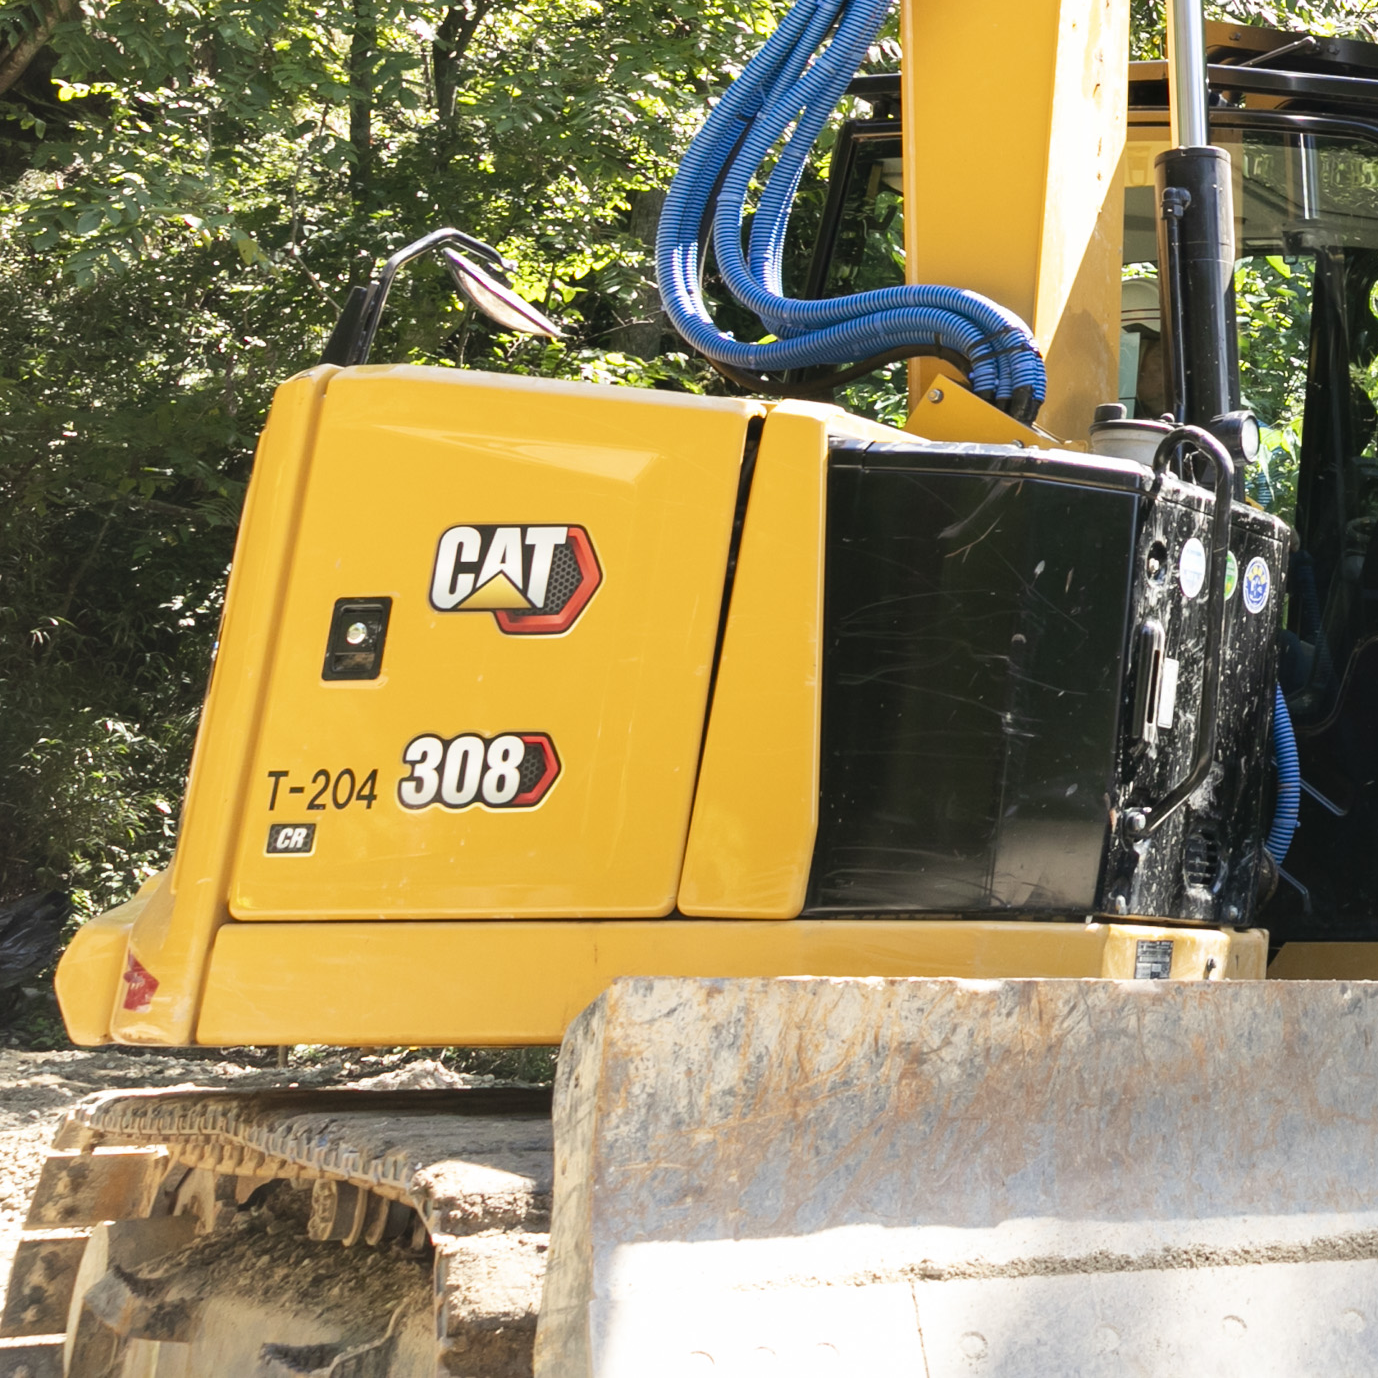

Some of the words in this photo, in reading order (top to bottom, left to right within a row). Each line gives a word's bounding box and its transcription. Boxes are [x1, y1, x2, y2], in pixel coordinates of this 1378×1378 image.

[431, 526, 569, 609] CAT
[267, 768, 379, 811] T-204
[400, 735, 525, 805] 308
[276, 827, 308, 849] CR
